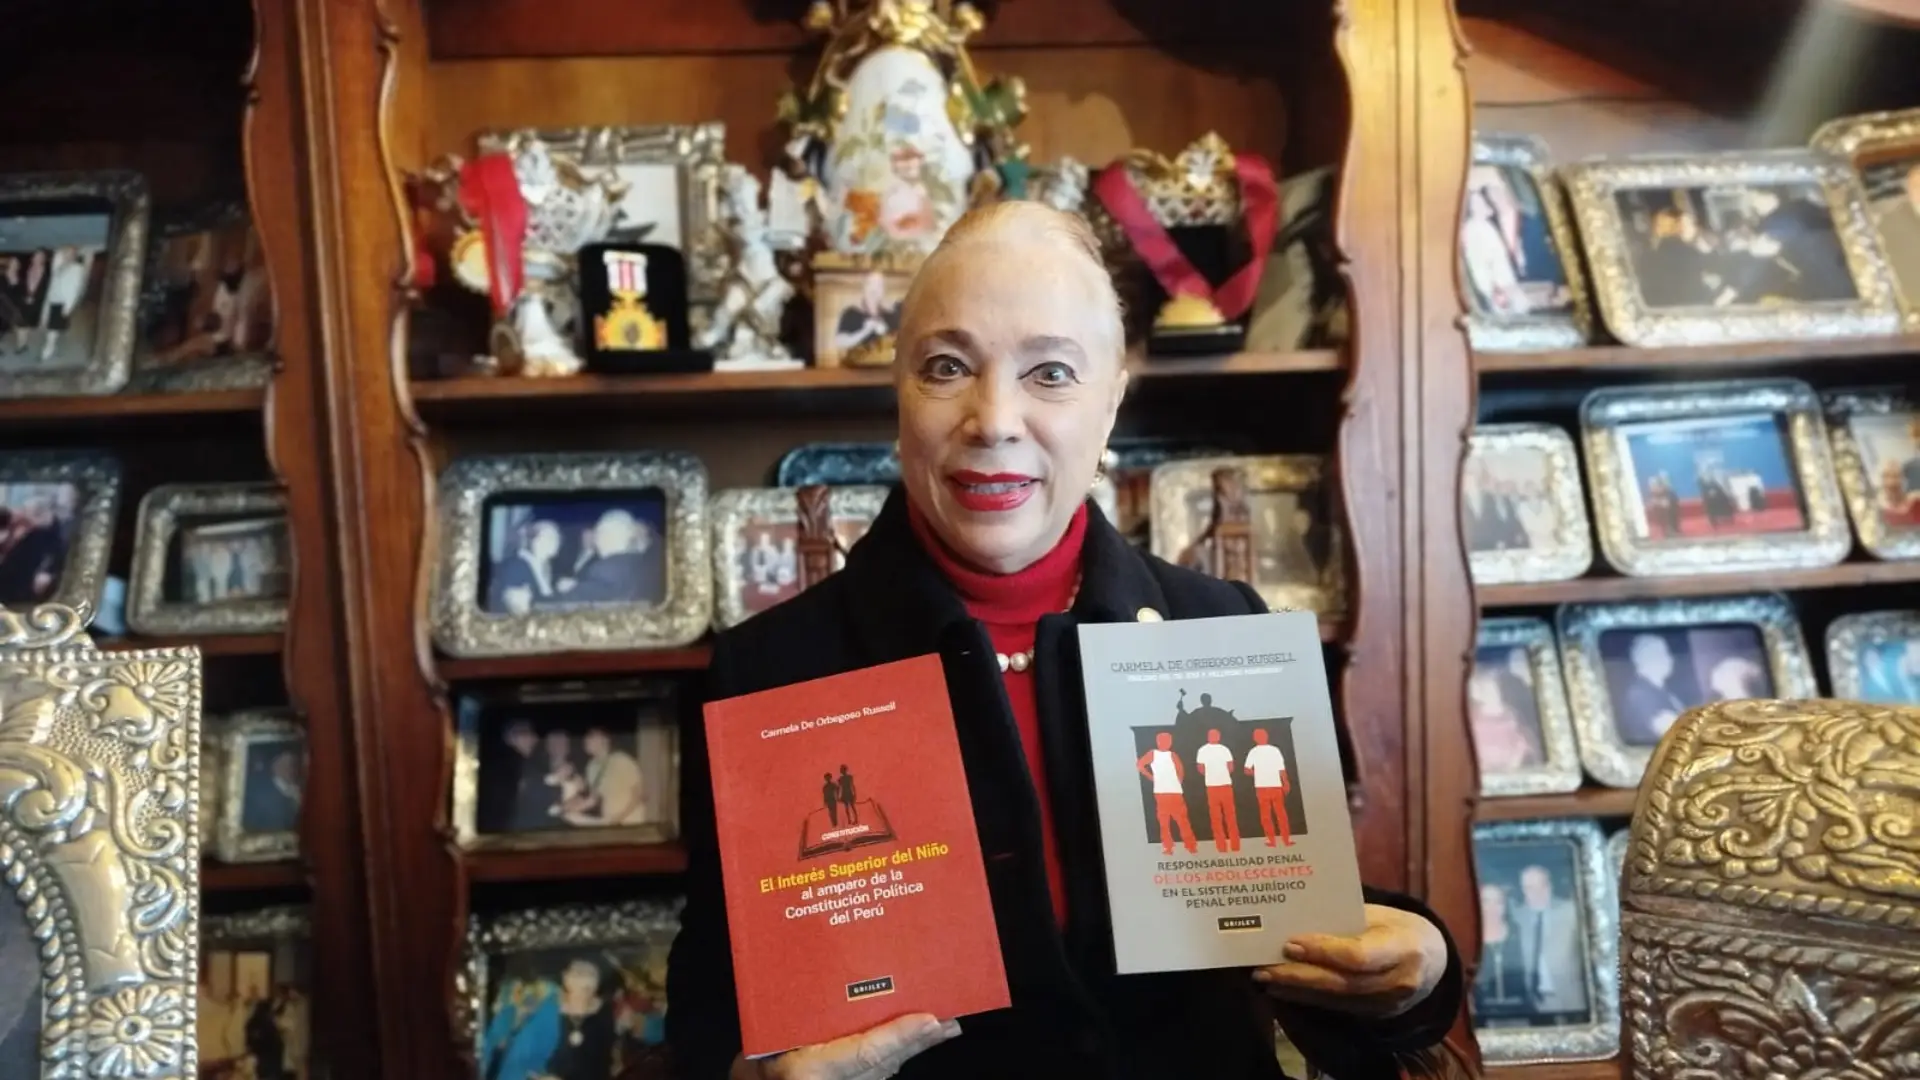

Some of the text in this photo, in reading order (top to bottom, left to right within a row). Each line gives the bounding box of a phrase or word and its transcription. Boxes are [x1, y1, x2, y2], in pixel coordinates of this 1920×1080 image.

[1110, 652, 1297, 673] CARMELA DE ORBEGOSO RUSSELL
[760, 701, 897, 740] Carmela De Orbegoso Russell
[760, 842, 949, 893] El Interés Superior del Niño
[1157, 853, 1305, 871] RESPONSABILIDAD PENAL
[801, 869, 903, 901] al amparo de la
[1153, 864, 1314, 886] DE LOS ADOLESCENTES
[785, 880, 924, 920] Constitución Política
[1162, 879, 1306, 898] EN EL SISTEMA JURÍDICO
[1186, 893, 1286, 909] PENAL PERUANO
[829, 902, 885, 926] del Perú
